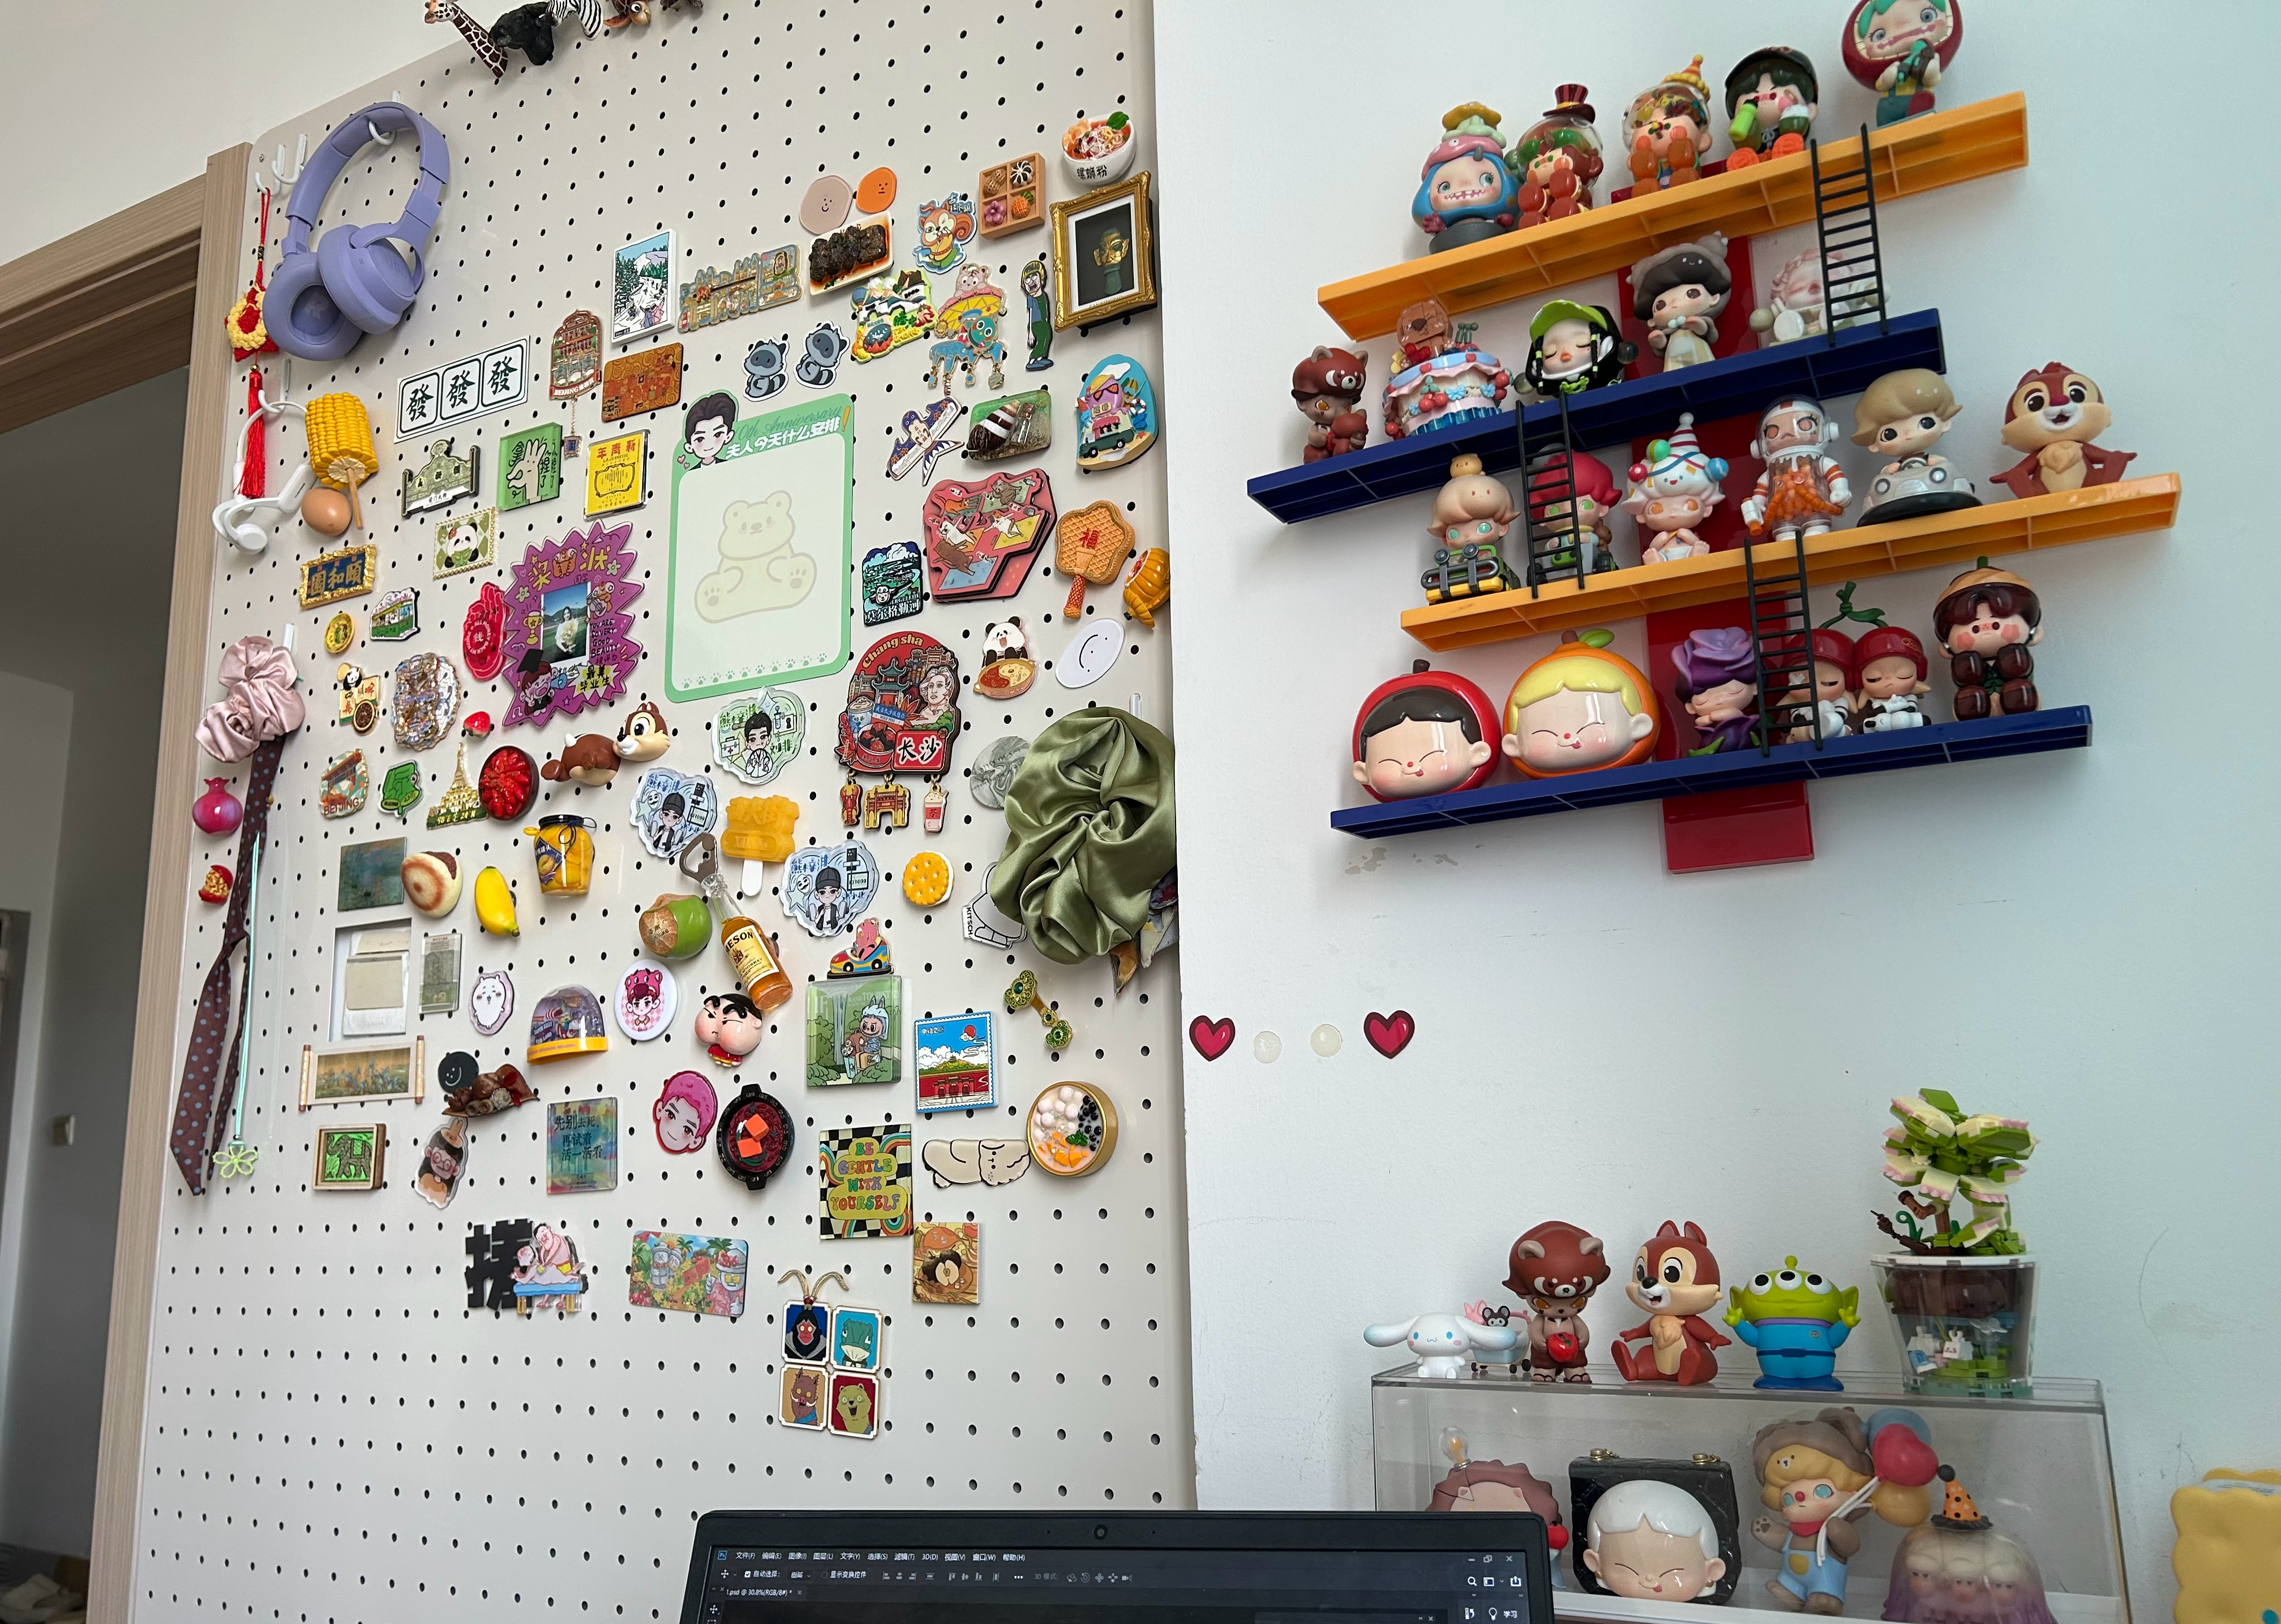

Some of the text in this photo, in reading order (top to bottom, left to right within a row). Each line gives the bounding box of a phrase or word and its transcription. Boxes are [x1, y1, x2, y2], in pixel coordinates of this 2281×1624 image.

[762, 406, 842, 435] Anniversary
[1079, 528, 1100, 548] 福
[591, 643, 619, 658] BEAUTY
[593, 637, 610, 647] GOOD
[580, 676, 610, 691] 毕业生
[898, 737, 940, 763] 长沙
[324, 797, 359, 816] BEIJING
[928, 808, 938, 818] 茶
[855, 1142, 874, 1156] BE
[838, 1158, 893, 1175] GENTLE
[847, 1176, 882, 1193] WITH
[830, 1193, 901, 1211] YOURSELF
[735, 1552, 755, 1560] 文件(F)
[839, 1552, 860, 1561] 文字(Y)
[972, 1553, 996, 1562] 窗口(W)
[1002, 1553, 1025, 1562] 帮助(H)
